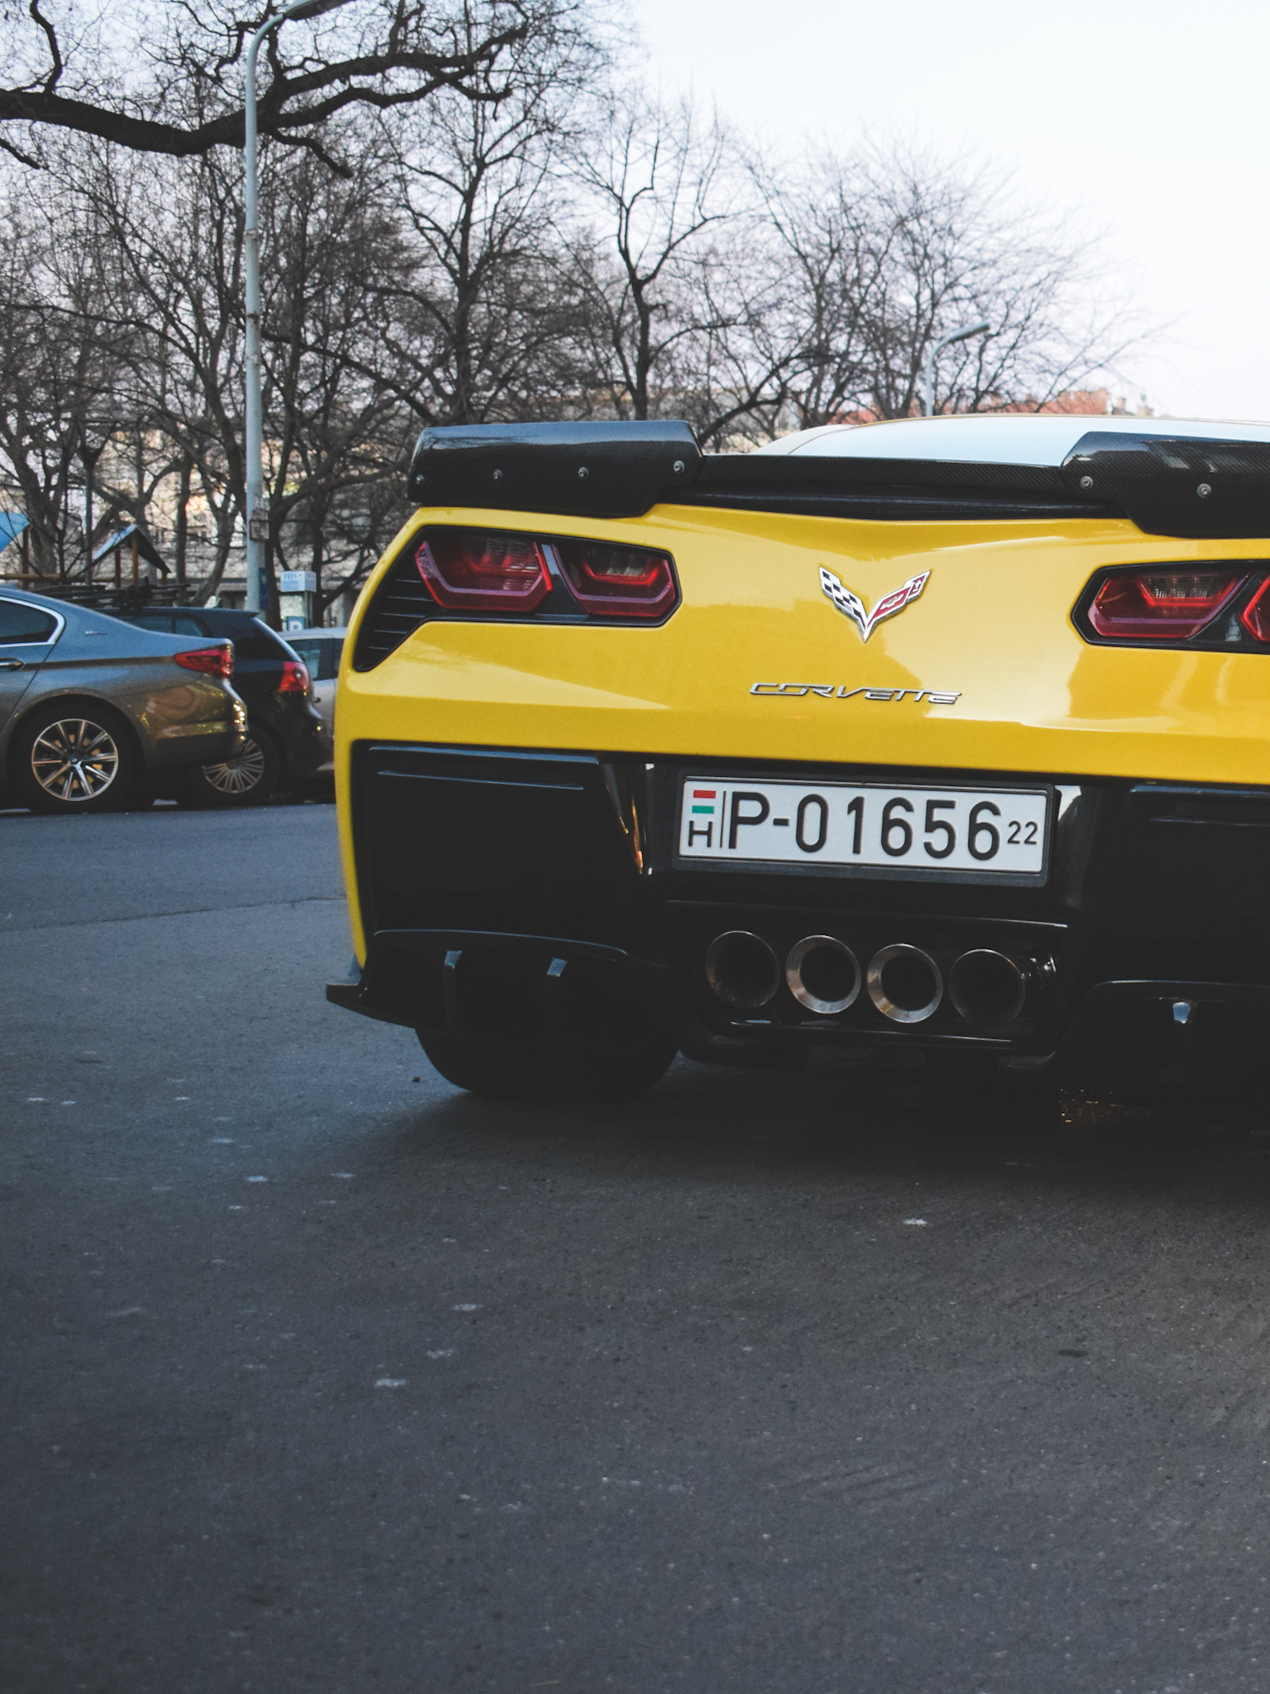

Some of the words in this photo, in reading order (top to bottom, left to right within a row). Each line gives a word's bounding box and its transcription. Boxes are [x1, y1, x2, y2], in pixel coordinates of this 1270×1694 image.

[750, 682, 962, 705] CORVETTE
[688, 820, 713, 848] H
[728, 791, 1001, 861] P-01656
[1007, 821, 1038, 846] 22
